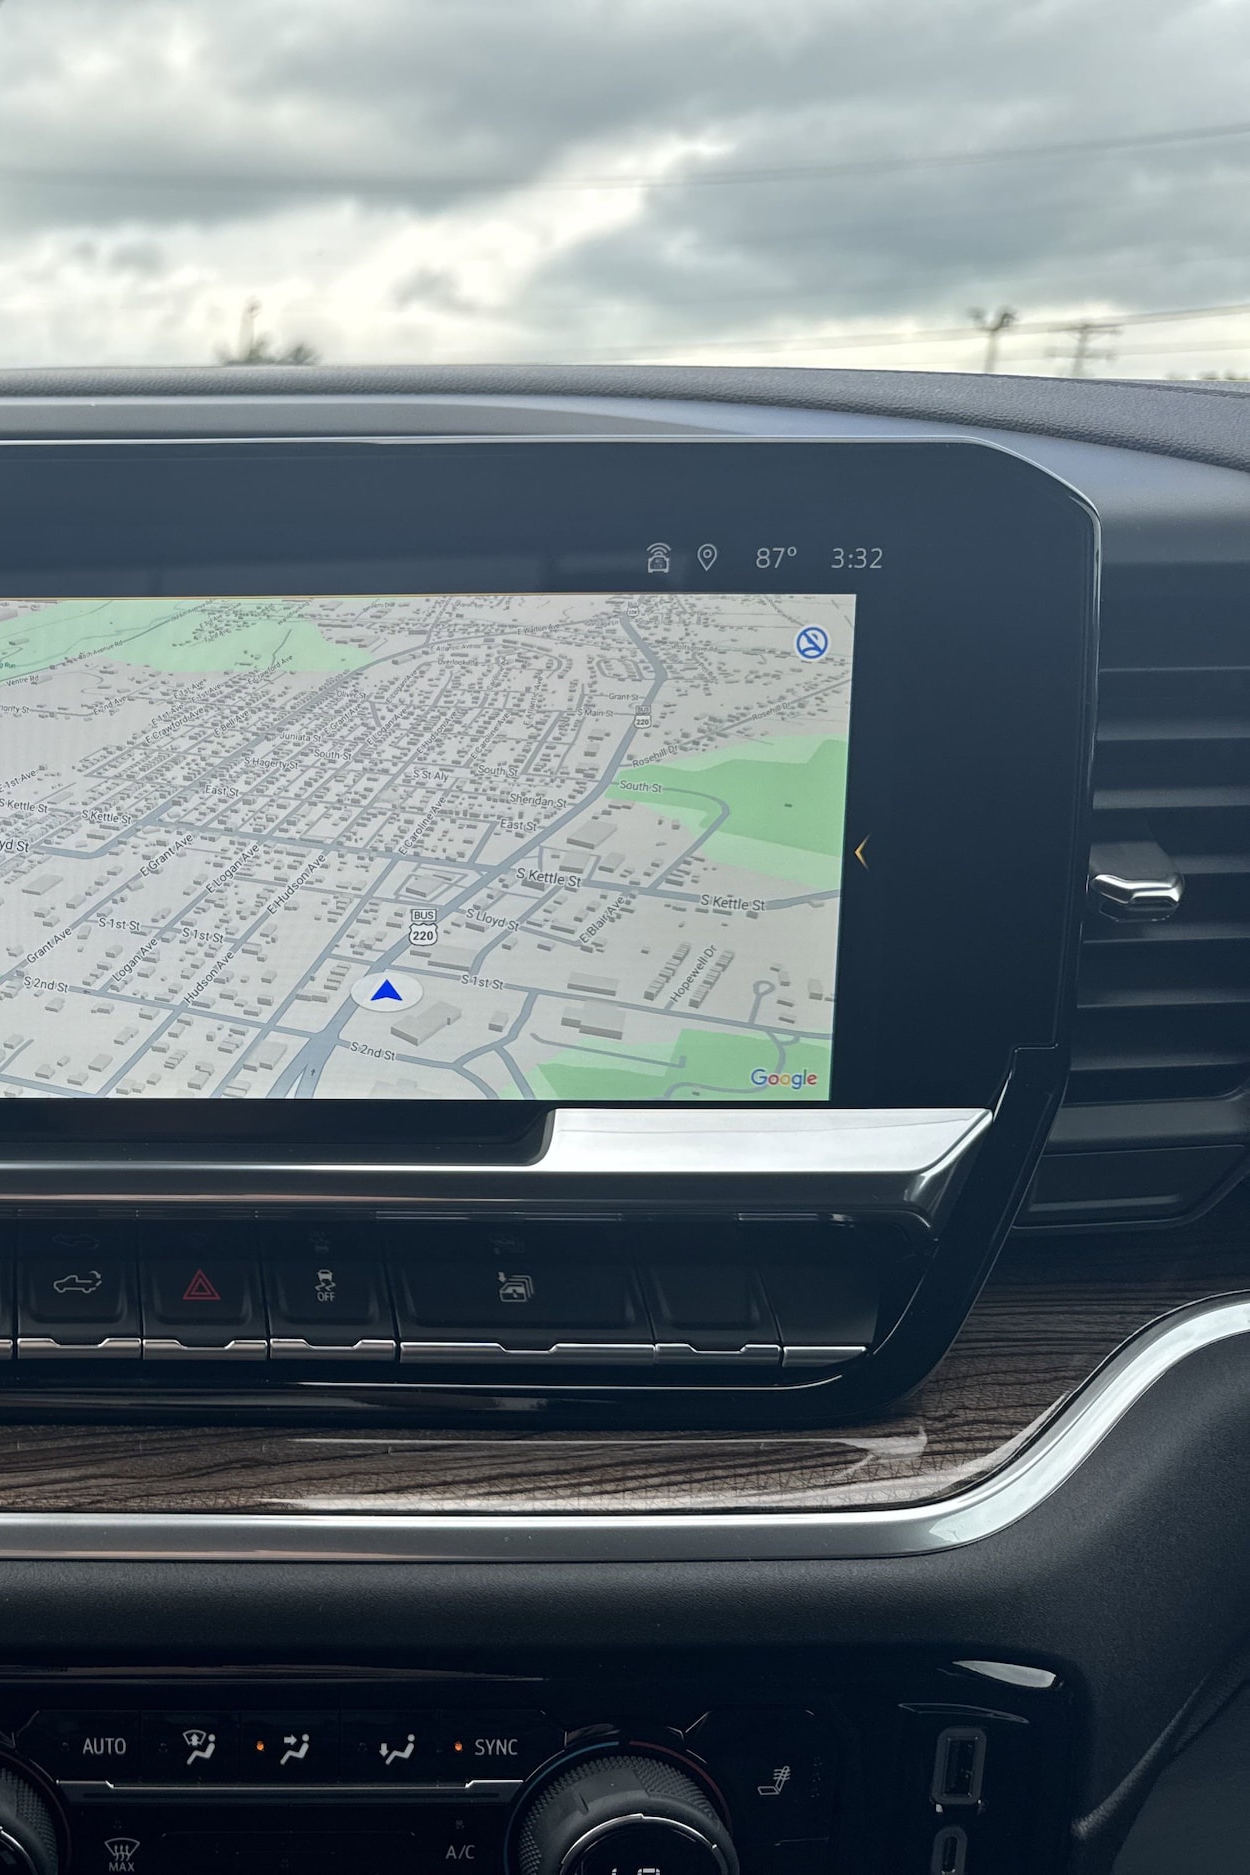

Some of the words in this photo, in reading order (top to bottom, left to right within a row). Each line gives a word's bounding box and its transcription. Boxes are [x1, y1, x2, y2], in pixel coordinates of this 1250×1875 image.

[756, 546, 797, 568] 87°
[831, 548, 882, 568] 3:32
[6, 677, 26, 687] Ventre
[28, 675, 40, 683] Rd
[20, 706, 30, 714] St
[585, 709, 604, 717] Main
[752, 705, 783, 721] Rosehill
[783, 702, 791, 711] Dr
[213, 727, 220, 736] E
[220, 718, 235, 732] Bell
[235, 709, 250, 721] Ave
[279, 731, 312, 743] Juniata
[313, 734, 322, 743] St
[244, 756, 251, 766] S
[252, 757, 288, 770] Hagerty
[289, 761, 299, 770] St
[632, 747, 668, 768] Rosehill
[667, 744, 679, 754] Dr
[413, 770, 420, 779] S
[422, 770, 432, 780] St
[434, 771, 449, 782] Aly
[477, 765, 506, 777] South
[508, 767, 518, 777] St
[205, 785, 227, 797] East
[229, 788, 240, 798] St
[619, 780, 649, 792] South
[651, 782, 662, 793] St
[7, 800, 36, 812] Kettle
[38, 803, 48, 814] St
[509, 793, 554, 807] Sheridan
[556, 798, 567, 809] St
[81, 809, 90, 819] S
[91, 810, 120, 823] Kettle
[121, 814, 132, 825] St
[500, 819, 524, 830] East
[526, 821, 538, 832] St
[16, 841, 30, 853] St
[140, 867, 150, 877] E
[149, 847, 176, 872] Grant
[175, 834, 194, 851] Ave
[266, 904, 277, 915] E
[274, 872, 312, 908] Hudson
[307, 854, 327, 875] Ave
[516, 867, 526, 879] S
[528, 869, 565, 885] Kettle
[567, 875, 582, 888] St
[701, 894, 710, 906] S
[712, 897, 749, 911] Kettle
[751, 899, 765, 911] St
[98, 917, 106, 928] S
[109, 918, 127, 930] 1st
[129, 920, 141, 931] St
[414, 911, 434, 921] BUS
[466, 909, 475, 919] S
[476, 911, 507, 929] Lloyd
[507, 920, 520, 932] St
[579, 934, 589, 944] E
[587, 912, 609, 937] Blair
[607, 895, 625, 914] Ave
[182, 927, 190, 938] S
[193, 929, 210, 941] 1st
[212, 932, 224, 944] St
[412, 931, 434, 942] 220
[26, 941, 54, 965] Grant
[53, 926, 73, 945] Ave
[112, 953, 142, 982] Logan
[139, 937, 158, 957] Ave
[183, 968, 220, 1004] Hudson
[216, 951, 235, 971] Ave
[670, 958, 707, 1002] Hopewell
[705, 943, 718, 960] Dr
[23, 976, 32, 987] S
[33, 977, 54, 990] 2nd
[57, 981, 69, 993] St
[461, 975, 469, 986] S
[472, 976, 490, 988] 1st
[492, 979, 504, 990] St
[350, 1042, 359, 1052] S
[360, 1044, 382, 1058] 2nd
[383, 1050, 396, 1062] St
[751, 1068, 818, 1090] Google
[317, 1291, 335, 1302] OFF
[83, 1738, 126, 1755] AUTO
[474, 1739, 518, 1756] SYNC
[445, 1845, 476, 1861] A/C
[109, 1862, 135, 1872] MAX
